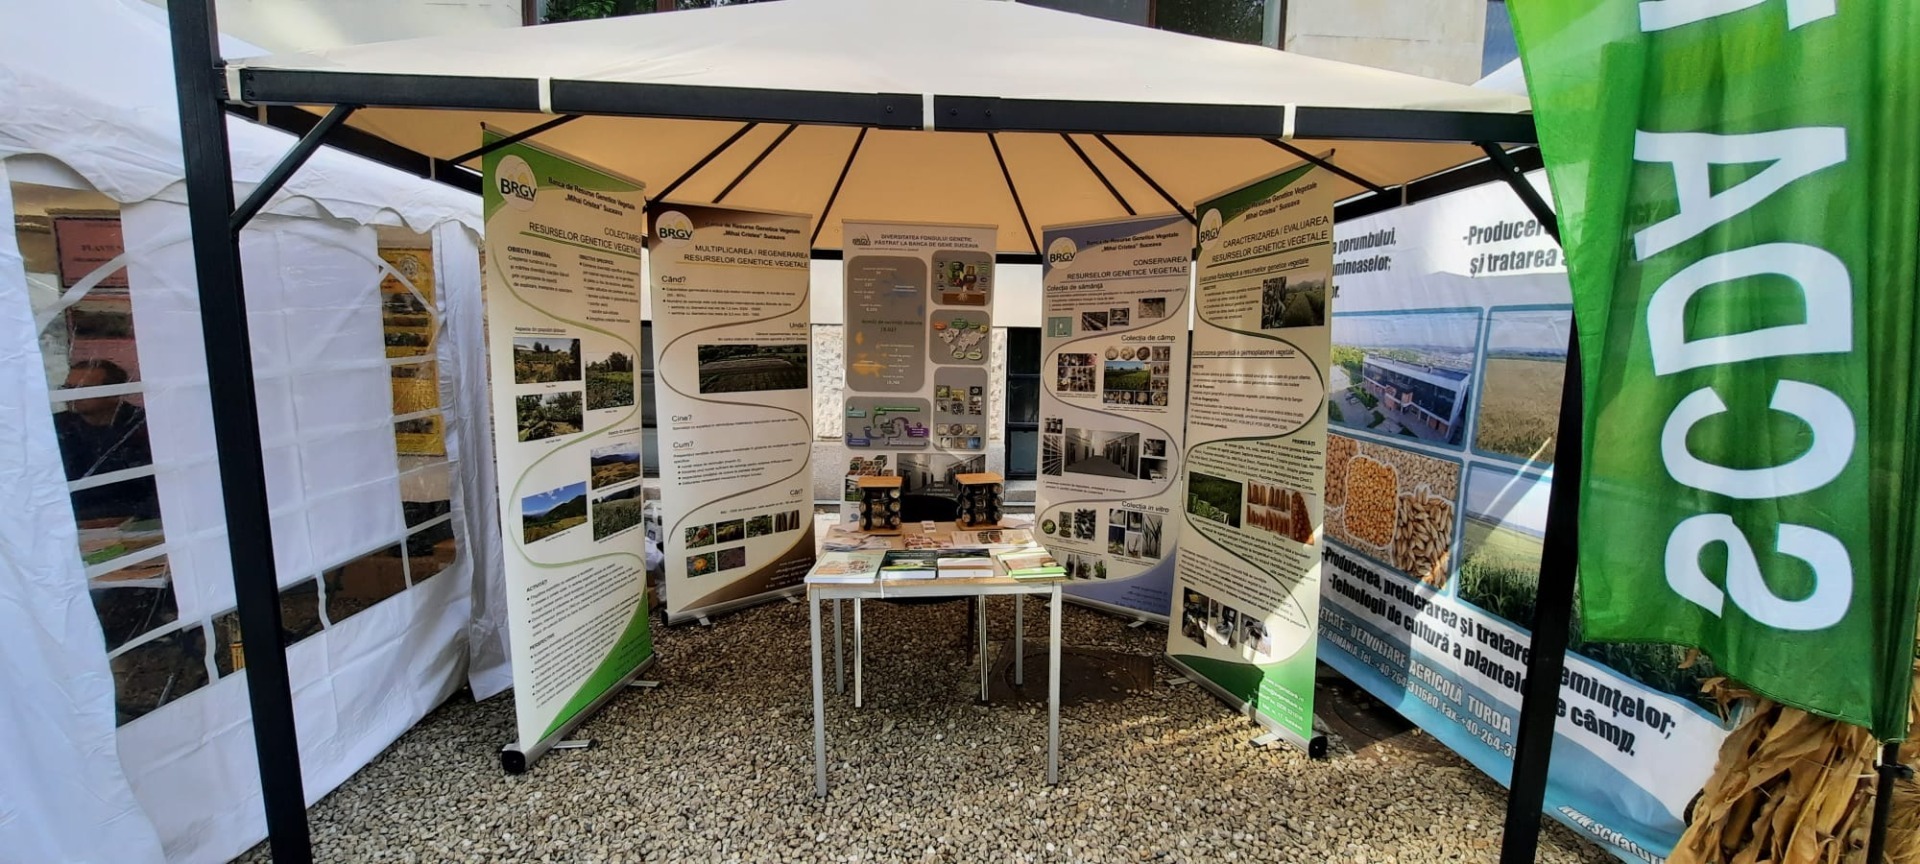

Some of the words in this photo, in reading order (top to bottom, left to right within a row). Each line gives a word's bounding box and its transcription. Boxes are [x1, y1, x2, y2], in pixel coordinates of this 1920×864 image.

[500, 178, 537, 199] BRGV
[566, 182, 575, 191] de
[574, 184, 595, 198] Resurse
[595, 192, 617, 205] Genetice
[618, 200, 636, 211] Vegetale
[1272, 191, 1294, 203] Genetice
[1294, 182, 1318, 195] Vegetale
[603, 204, 623, 216] Suceava
[1279, 199, 1300, 211] Suceava
[529, 221, 579, 241] RESURSELOR
[580, 235, 613, 250] GENETICE
[659, 227, 693, 239] BRGV
[755, 225, 778, 233] Genetice
[1200, 227, 1221, 243] BRGV
[1223, 229, 1280, 249] CARACTERIZAREA
[1283, 215, 1329, 234] EVALUAREA
[1462, 217, 1551, 247] -Producer
[1110, 236, 1131, 244] Resurse
[1156, 232, 1179, 241] Vegetale
[1139, 241, 1162, 249] Suceava
[1212, 248, 1252, 263] RESURSELOR
[1252, 240, 1286, 254] GENETICE
[1287, 230, 1328, 246] VEGETALE
[1338, 227, 1397, 255] porumbului,
[695, 244, 752, 255] MULTIPLICAREA
[758, 248, 808, 259] REGENERAREA
[1050, 252, 1076, 263] BRGV
[684, 254, 735, 264] RESURSELOR
[737, 257, 773, 267] GENETICE
[774, 258, 808, 269] VEGETALE
[1133, 256, 1188, 266] CONSERVAREA
[1243, 265, 1267, 275] resurselor
[1267, 262, 1287, 272] genetice
[1287, 257, 1309, 269] vegetale
[1487, 249, 1558, 273] tratarea
[661, 275, 686, 283] Când?
[1067, 271, 1112, 280] RESURSELOR
[1112, 268, 1148, 277] GENETICE
[1148, 265, 1188, 276] VEGETALE
[1156, 334, 1176, 343] câmp
[671, 414, 693, 422] Cine?
[672, 441, 694, 449] Cum?
[1321, 546, 1383, 591] -Producerea,
[1383, 578, 1458, 629] prelucrarea
[1476, 623, 1531, 667] tratare
[1328, 573, 1386, 618] -Tehnologii
[1387, 604, 1403, 626] de
[1403, 614, 1450, 654] cultură
[1453, 641, 1462, 660] a
[1464, 649, 1528, 697] plantelo
[1320, 605, 1345, 631] ETARE
[1350, 624, 1407, 668] DEZVOLTARE
[1408, 659, 1464, 706] AGRICOLĂ
[1467, 694, 1512, 737] TURDA
[1561, 665, 1676, 740] emințelor;
[1570, 705, 1636, 757] câmp.
[1557, 805, 1667, 864] www.scdatur
